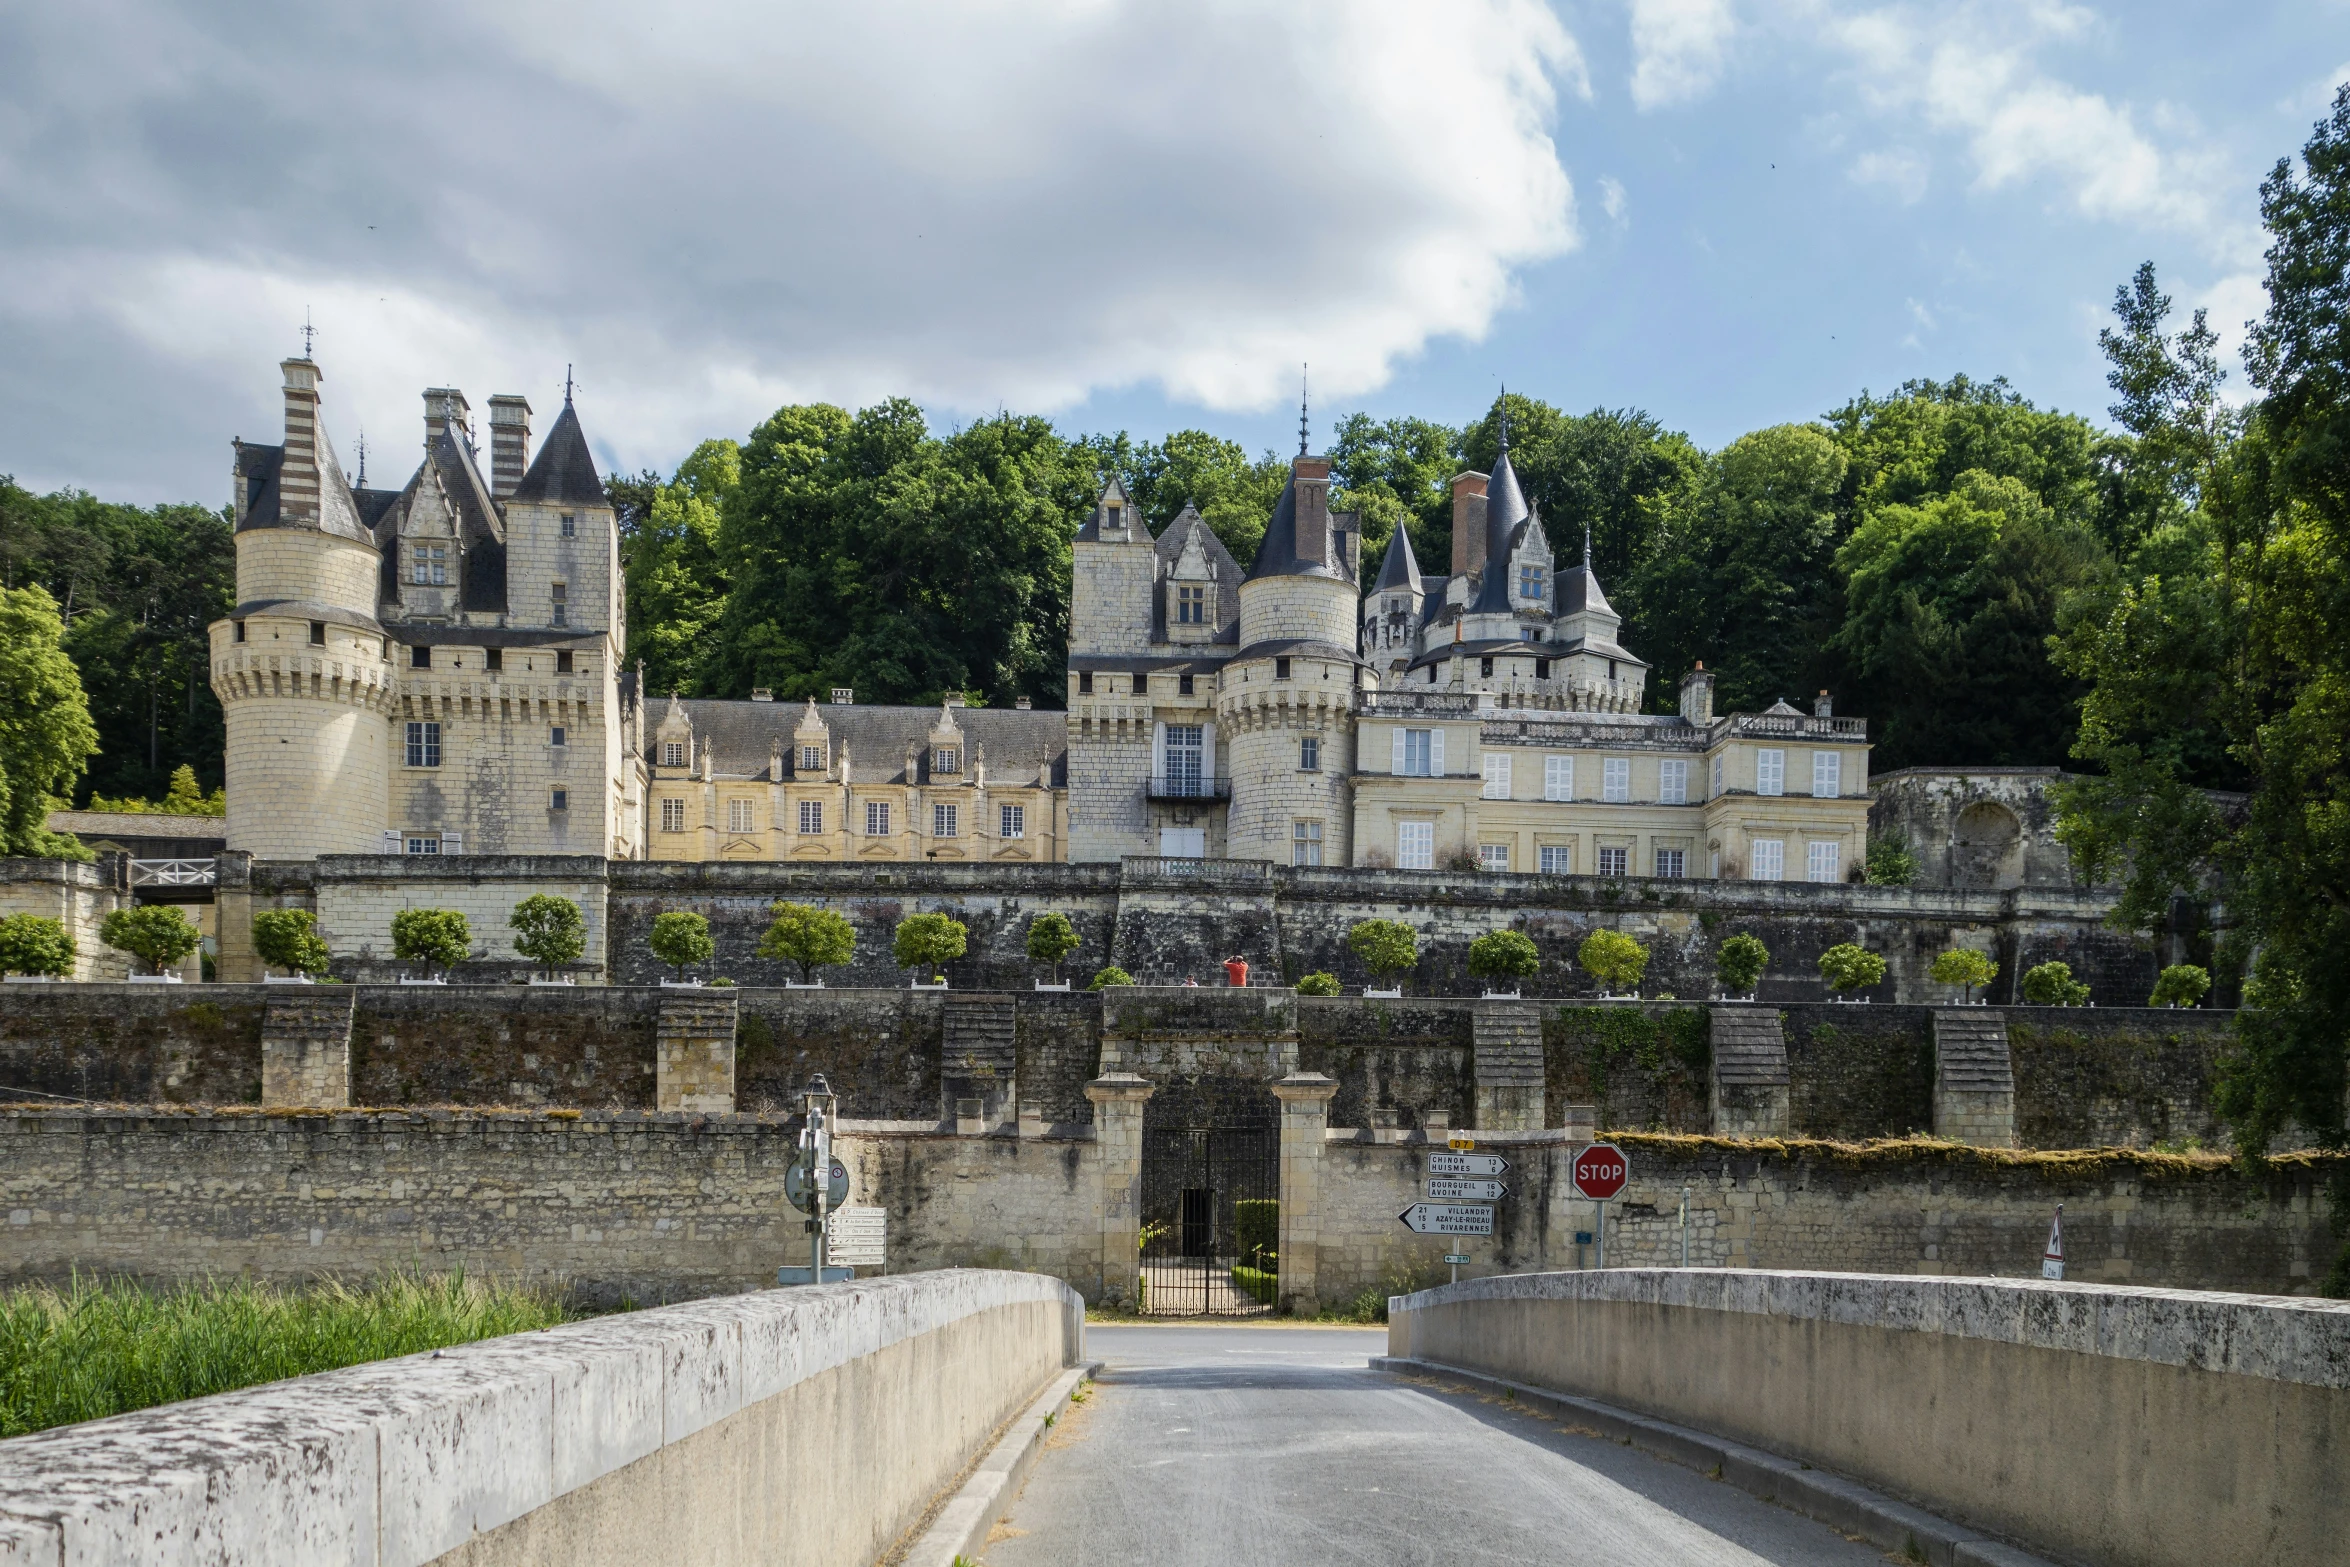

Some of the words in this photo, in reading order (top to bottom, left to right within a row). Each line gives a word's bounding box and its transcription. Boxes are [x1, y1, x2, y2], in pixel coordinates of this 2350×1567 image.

[1432, 1156, 1465, 1164] CHINON
[1431, 1164, 1471, 1172] HUISMES
[1579, 1164, 1622, 1180] STOP
[1431, 1181, 1476, 1190] BOURGUEIL
[1447, 1207, 1491, 1216] VILLANDRY
[1435, 1215, 1490, 1224] AZAY-LE-RIDEAU
[1440, 1224, 1490, 1232] RIVARENNES
